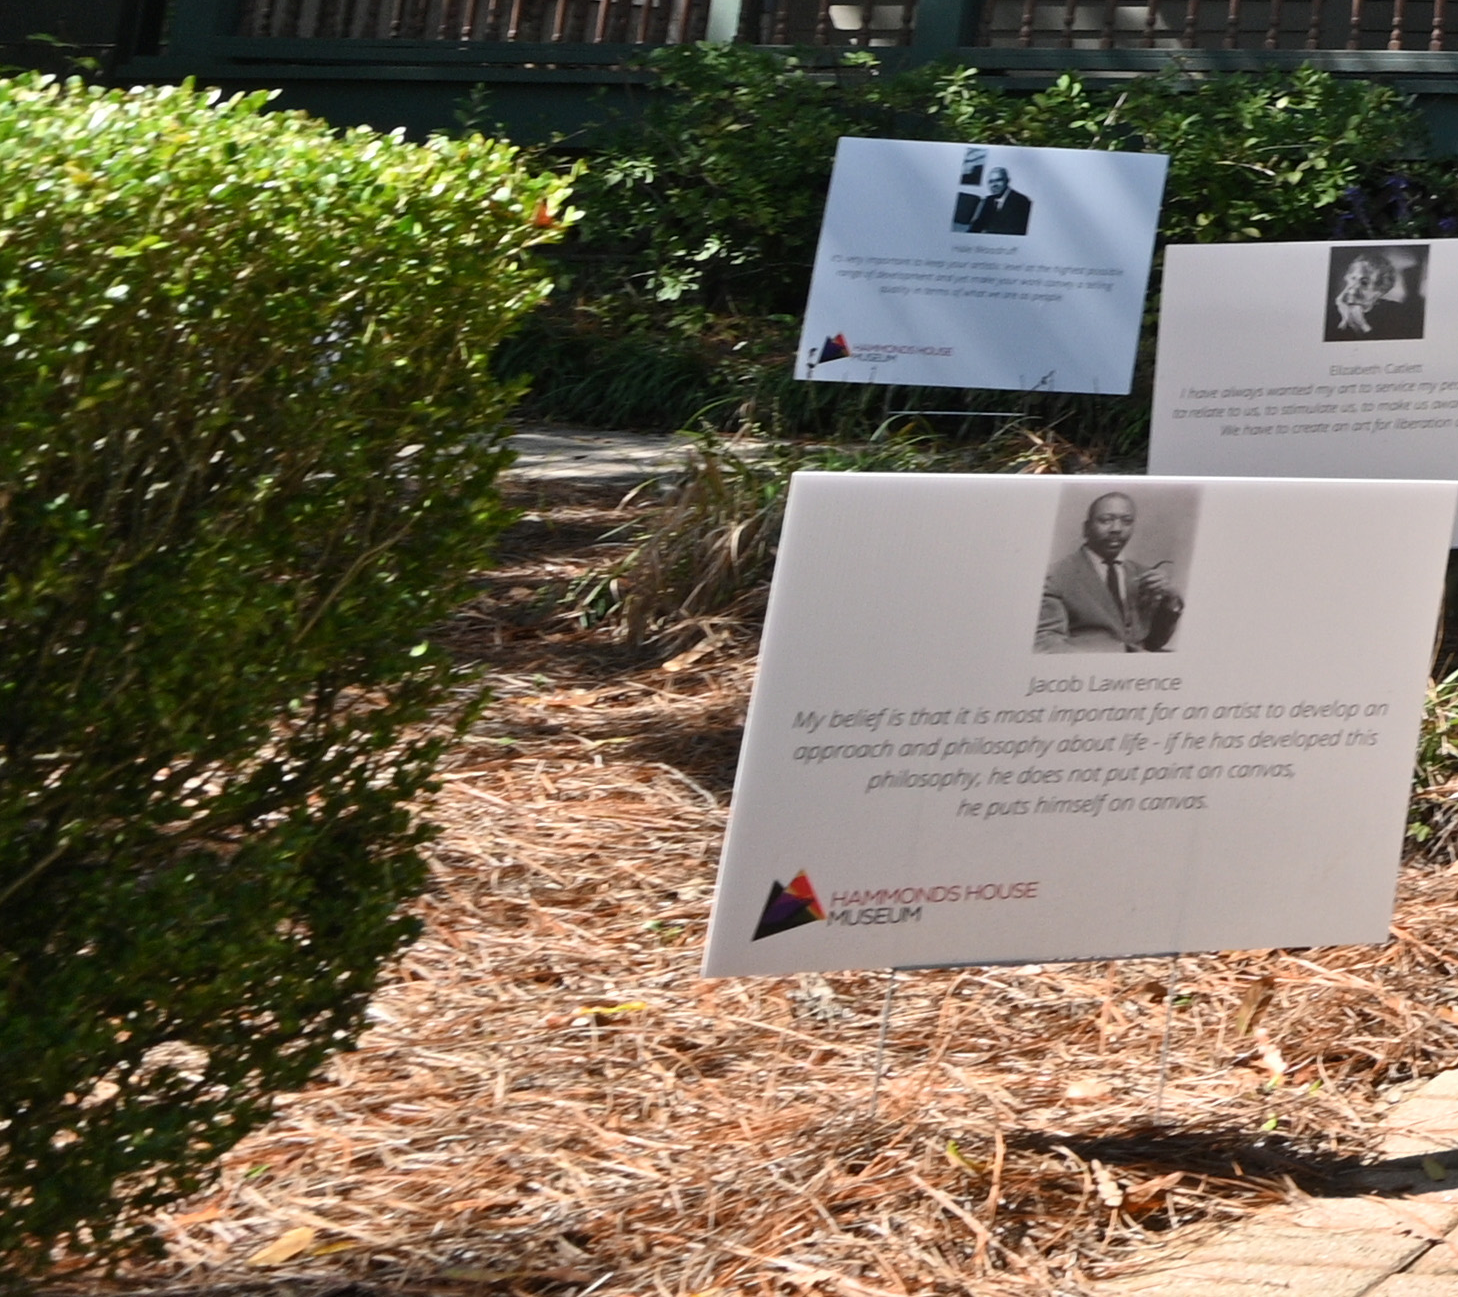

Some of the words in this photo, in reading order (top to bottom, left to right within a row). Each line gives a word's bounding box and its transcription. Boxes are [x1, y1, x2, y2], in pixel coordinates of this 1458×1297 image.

[1025, 675, 1083, 699] Jacob
[1088, 674, 1182, 692] Lawrence
[792, 709, 826, 734] My
[828, 708, 888, 734] belief
[886, 709, 906, 726] is
[909, 706, 952, 726] that
[954, 708, 971, 725] it
[973, 708, 991, 724] is
[993, 706, 1045, 724] most
[1048, 704, 1147, 729] important
[1147, 701, 1180, 727] for
[1181, 706, 1209, 720] an
[1212, 701, 1262, 719] artist
[1265, 701, 1285, 718] to
[1289, 697, 1360, 723] develop
[1363, 702, 1389, 716] an
[793, 738, 894, 765] approach
[898, 737, 942, 756] and
[941, 734, 1054, 761] philosophy
[1056, 733, 1116, 752] about
[1119, 732, 1149, 757] life
[1163, 731, 1183, 756] if
[1181, 731, 1206, 750] he
[1208, 730, 1244, 749] has
[1248, 727, 1343, 754] developed
[1345, 726, 1378, 746] this
[865, 767, 980, 794] philosophy,
[987, 766, 1014, 785] he
[1016, 764, 1064, 784] does
[1067, 765, 1102, 783] not
[1102, 764, 1140, 788] put
[1140, 763, 1194, 787] paint
[1197, 765, 1223, 779] on
[956, 797, 983, 817] he
[983, 798, 1030, 822] puts
[1034, 793, 1108, 820] himself
[1108, 797, 1135, 811] on
[830, 885, 961, 906] HAMMONDS
[964, 881, 1039, 901] HOUSE
[826, 906, 922, 927] MUSEUM
